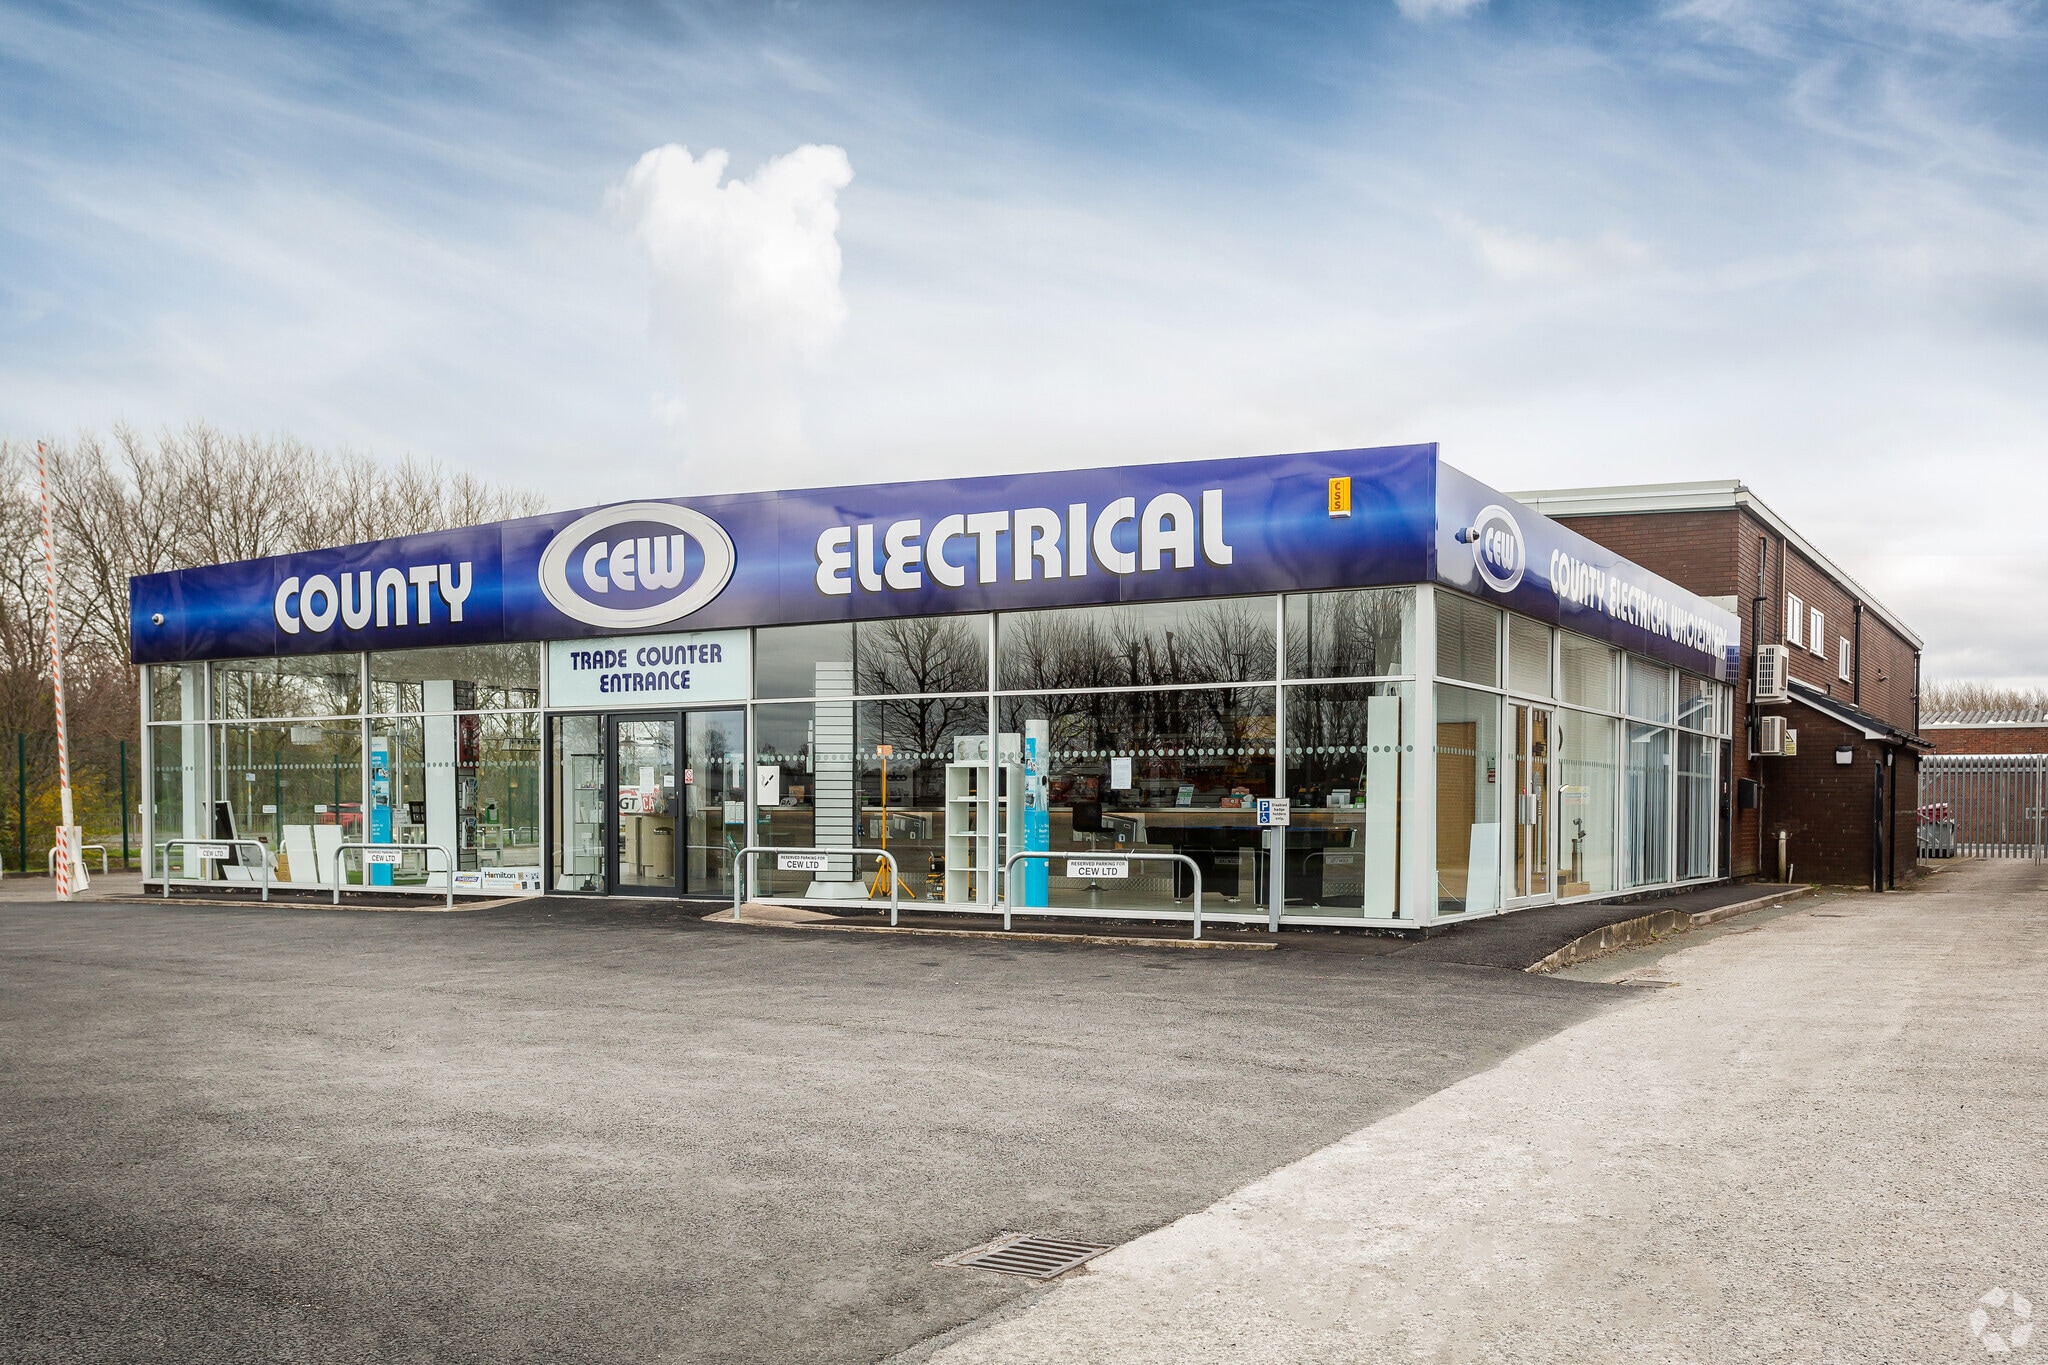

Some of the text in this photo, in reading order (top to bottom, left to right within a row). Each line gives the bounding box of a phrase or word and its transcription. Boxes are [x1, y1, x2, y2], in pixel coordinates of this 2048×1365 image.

[815, 489, 1233, 596] ELECTRICAL
[1485, 527, 1515, 571] CEW
[582, 534, 685, 594] CEW
[274, 561, 473, 635] COUNTY
[1550, 548, 1728, 661] COUNTY ELECTRICAL WHOLESALERS
[570, 643, 722, 671] TRADE COUNTER
[599, 670, 691, 693] ENTRANCE
[371, 854, 385, 862] CEW
[786, 860, 820, 869] CEW LTD
[1078, 867, 1118, 876] CEW LTD
